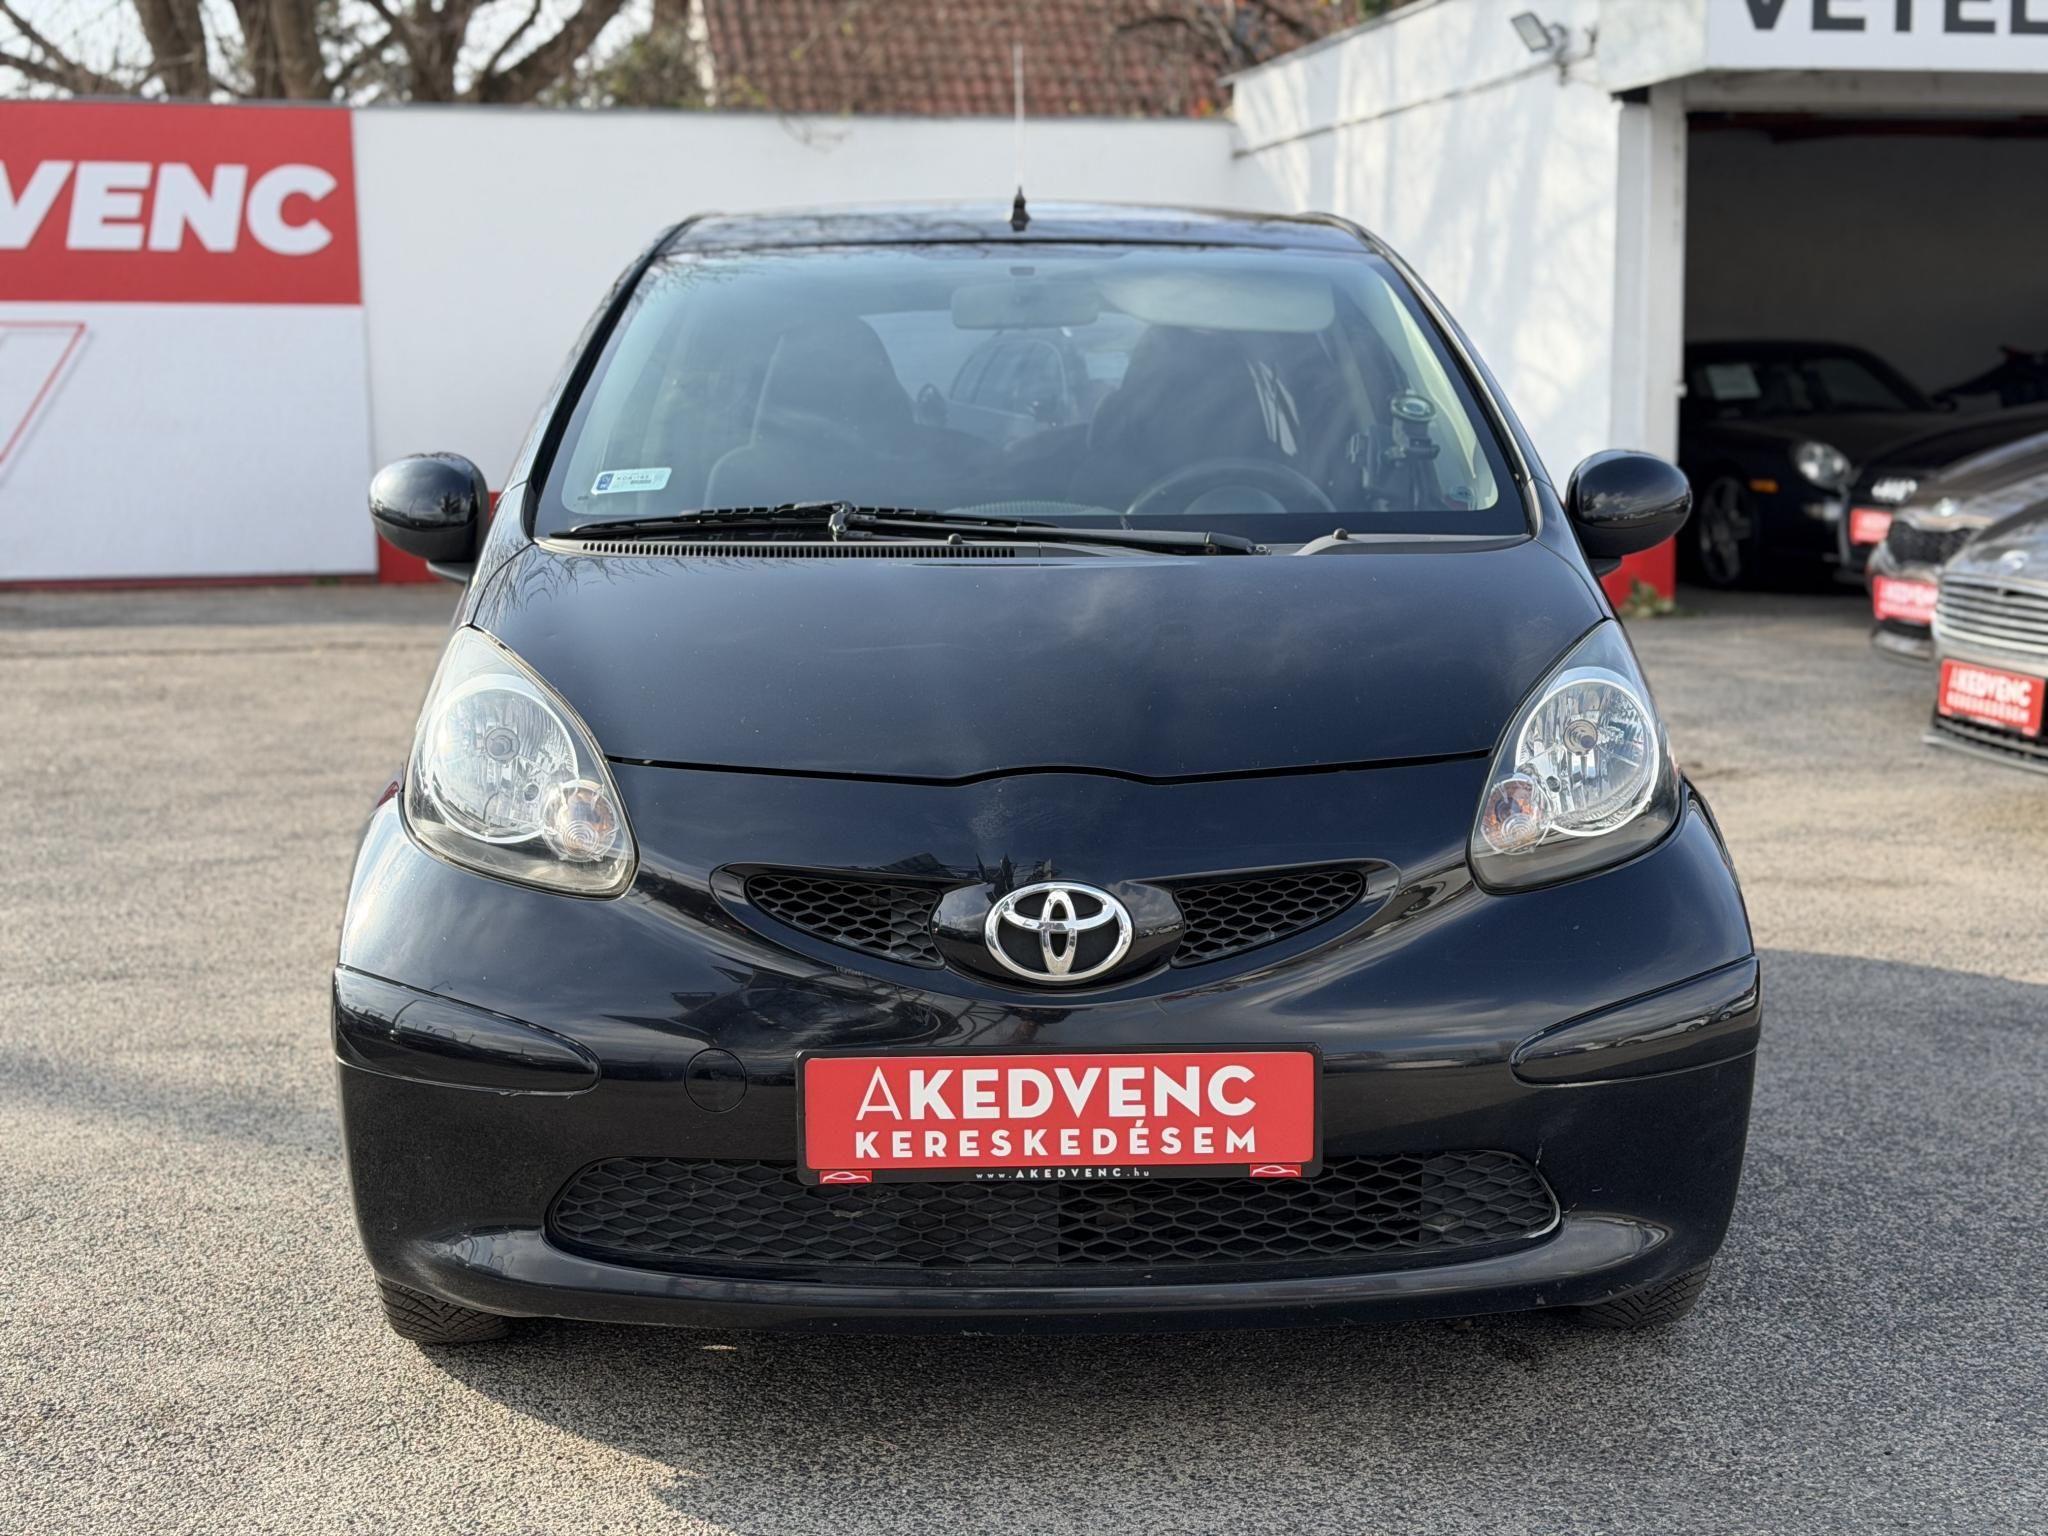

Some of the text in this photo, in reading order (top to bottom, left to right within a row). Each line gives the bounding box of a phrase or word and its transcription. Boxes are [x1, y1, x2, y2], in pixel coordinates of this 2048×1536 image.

[855, 1065, 1257, 1120] AKEDVENC
[855, 1119, 1256, 1159] KERESKEDÉSEM
[976, 1167, 1150, 1179] www.AKEDVENC.hu
